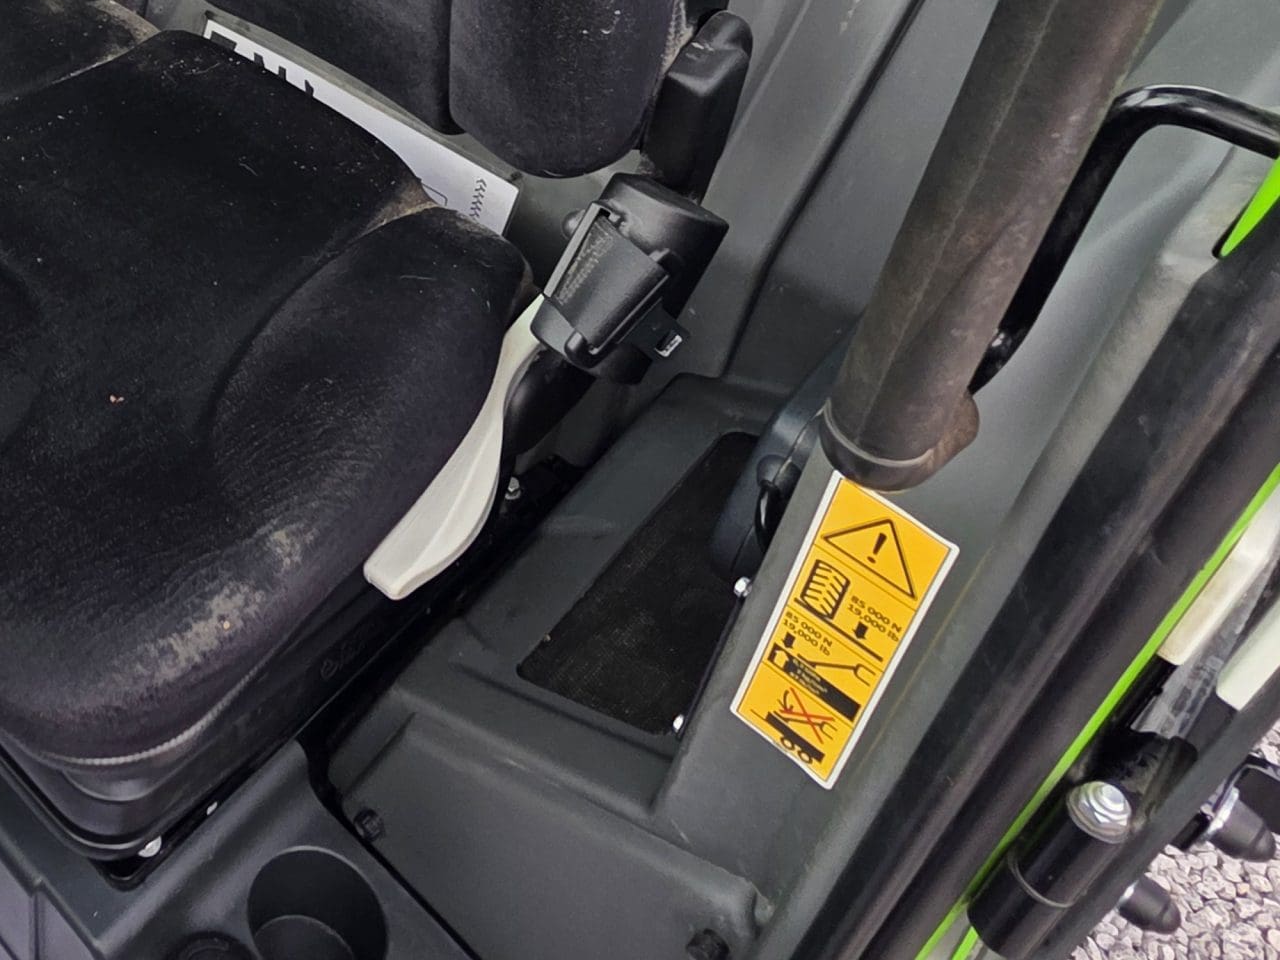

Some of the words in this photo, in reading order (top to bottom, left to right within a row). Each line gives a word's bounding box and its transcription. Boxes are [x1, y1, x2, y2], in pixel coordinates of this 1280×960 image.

[785, 611, 799, 623] 85
[801, 620, 822, 639] 000
[823, 637, 833, 647] N
[848, 604, 886, 633] 19,000
[887, 630, 899, 642] lb
[851, 595, 866, 608] 85
[867, 606, 891, 625] 000
[891, 623, 902, 633] N
[783, 619, 818, 647] 19,000
[819, 645, 831, 656] lb
